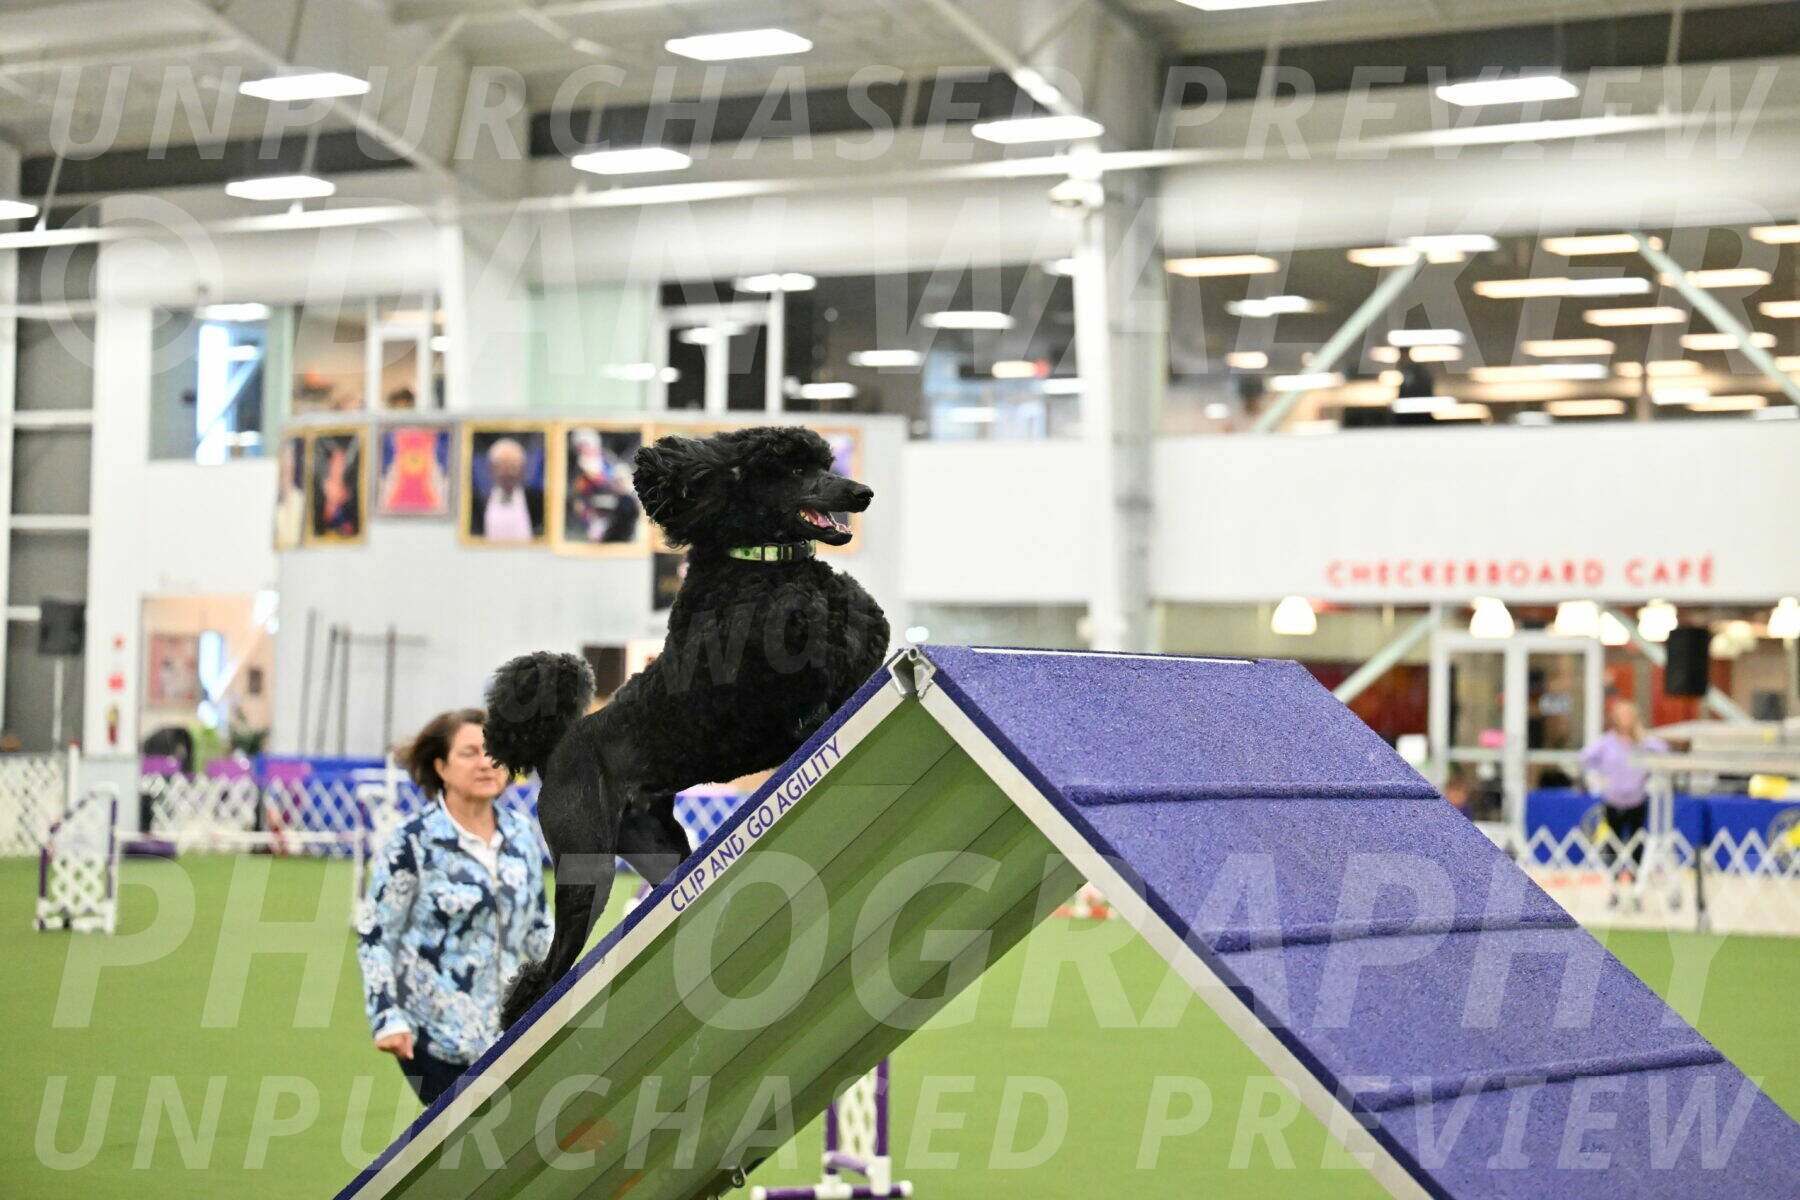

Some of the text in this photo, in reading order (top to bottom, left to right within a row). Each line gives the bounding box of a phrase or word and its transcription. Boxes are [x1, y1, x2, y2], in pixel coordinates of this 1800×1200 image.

[1326, 553, 1718, 587] CHECKERBOARD CAFÉ
[670, 736, 842, 912] CLIP AND GO AGILITY
